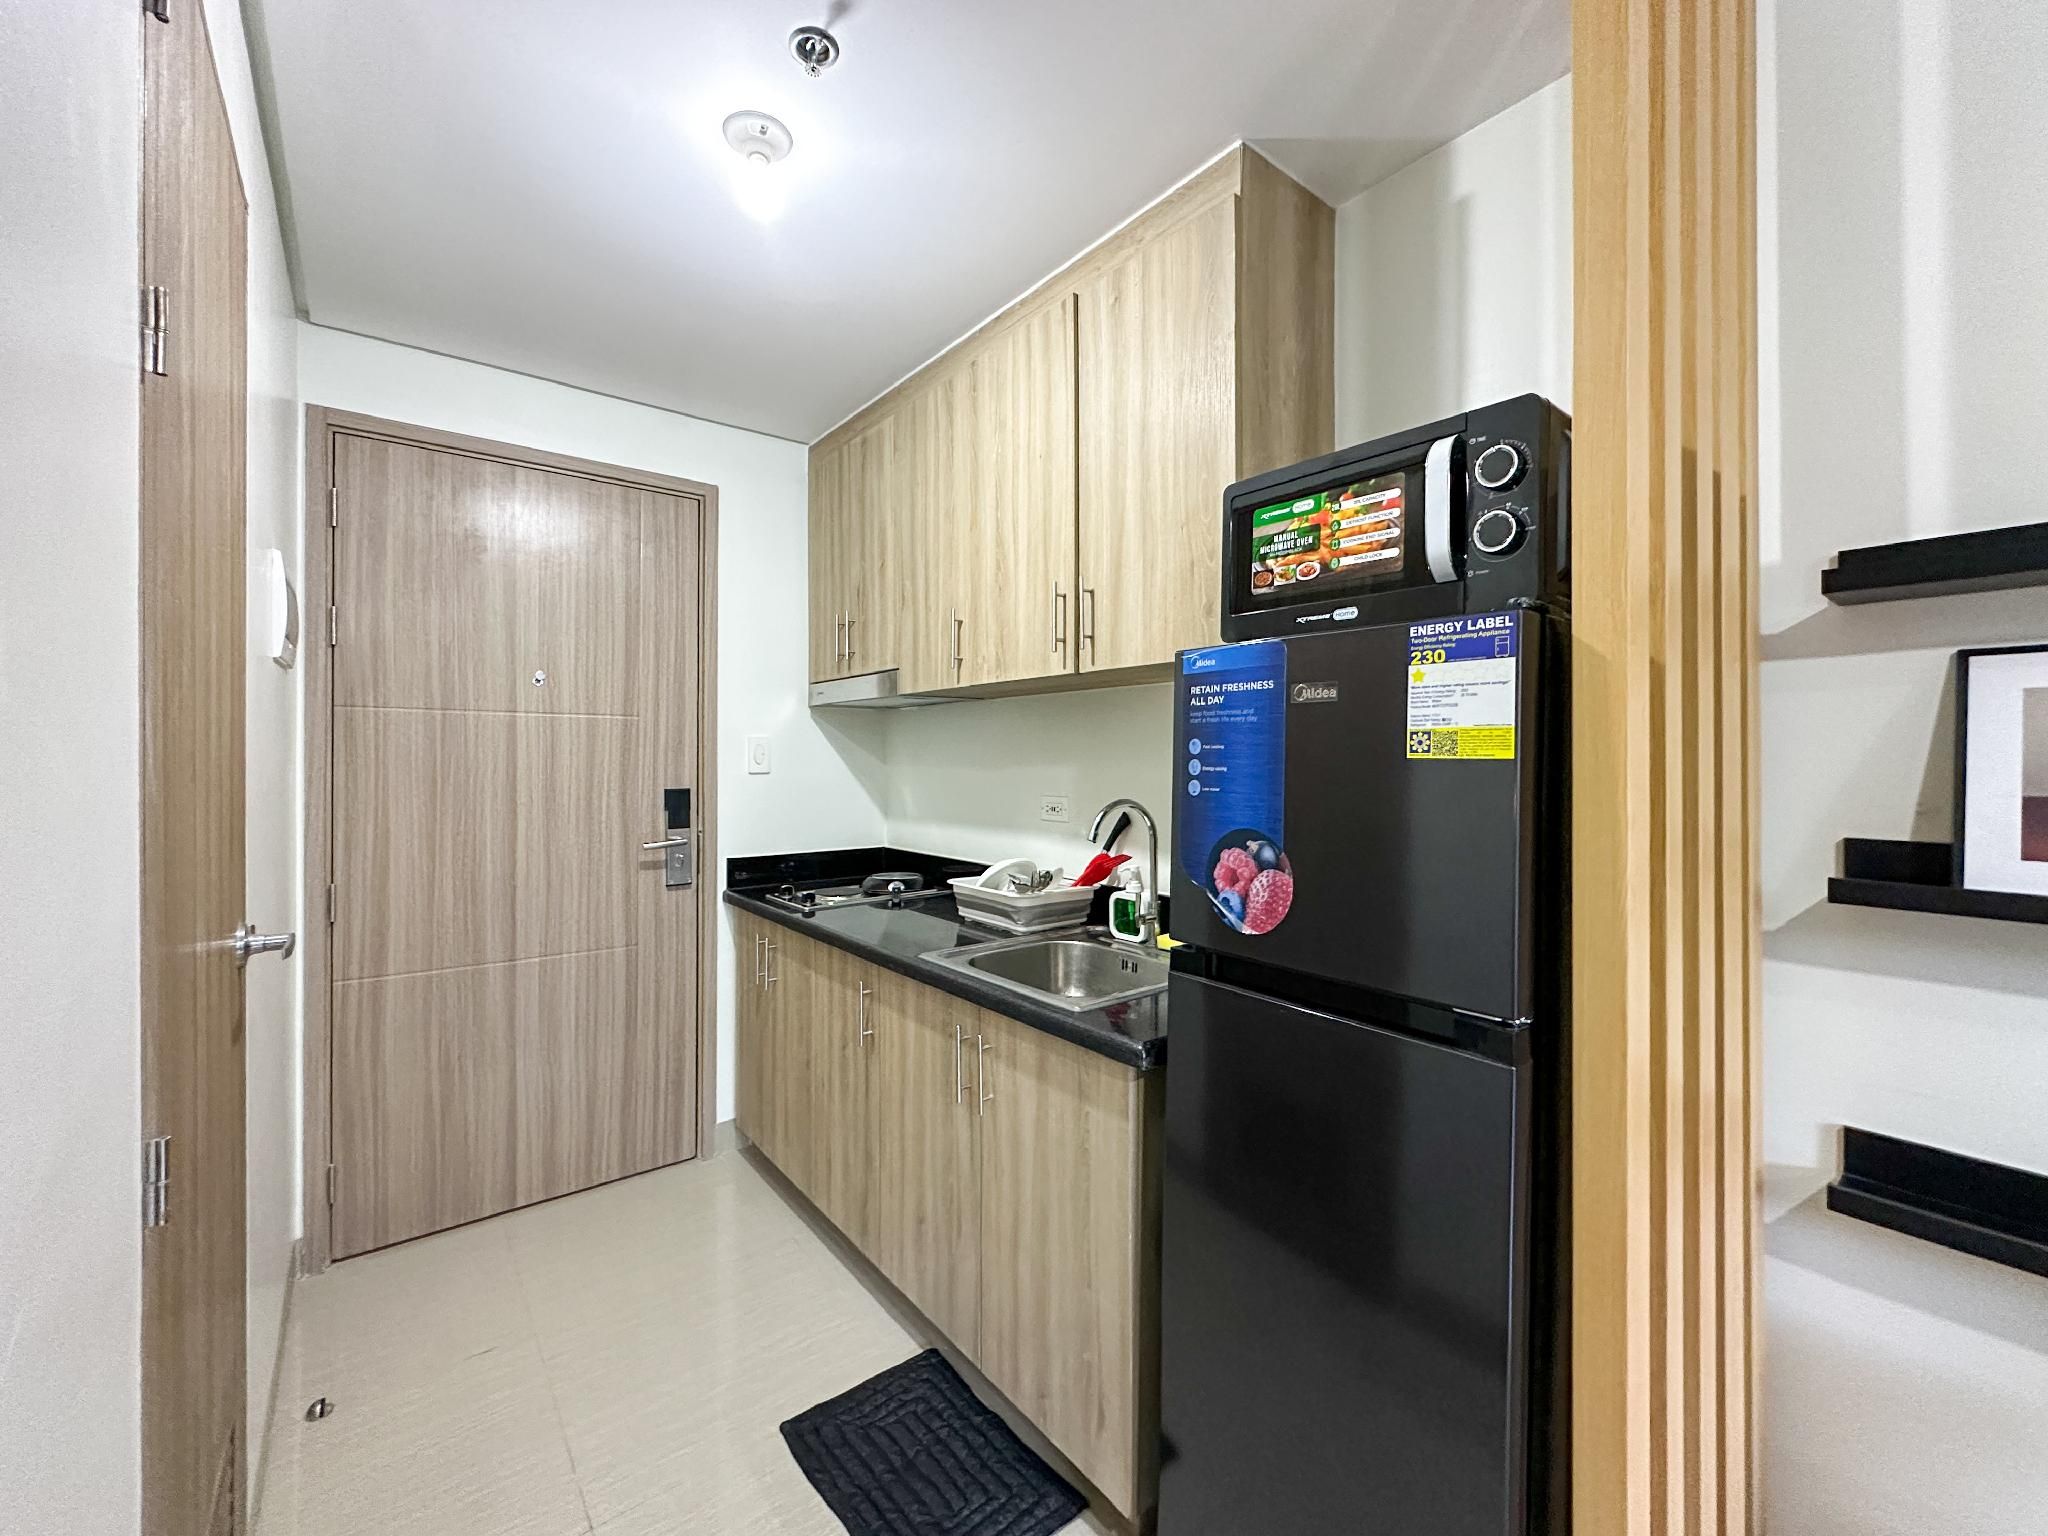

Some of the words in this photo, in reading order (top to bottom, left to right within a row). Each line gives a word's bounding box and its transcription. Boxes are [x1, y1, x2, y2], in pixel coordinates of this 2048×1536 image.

[1273, 531, 1298, 543] MANUAL
[1260, 540, 1295, 554] MICROWAVE
[1296, 536, 1313, 547] OVEN
[1409, 620, 1464, 637] ENERGY
[1467, 615, 1514, 631] LABEL
[1411, 636, 1437, 644] Two-Door
[1438, 632, 1478, 641] Refrigerating
[1478, 629, 1511, 638] Appliance
[1190, 656, 1216, 669] Midea
[1410, 649, 1446, 666] 230
[1190, 683, 1221, 695] RETAIN
[1222, 680, 1275, 693] FRESHNESS
[1293, 683, 1337, 701] Midea
[1190, 696, 1206, 706] ALL
[1207, 695, 1225, 705] DAY
